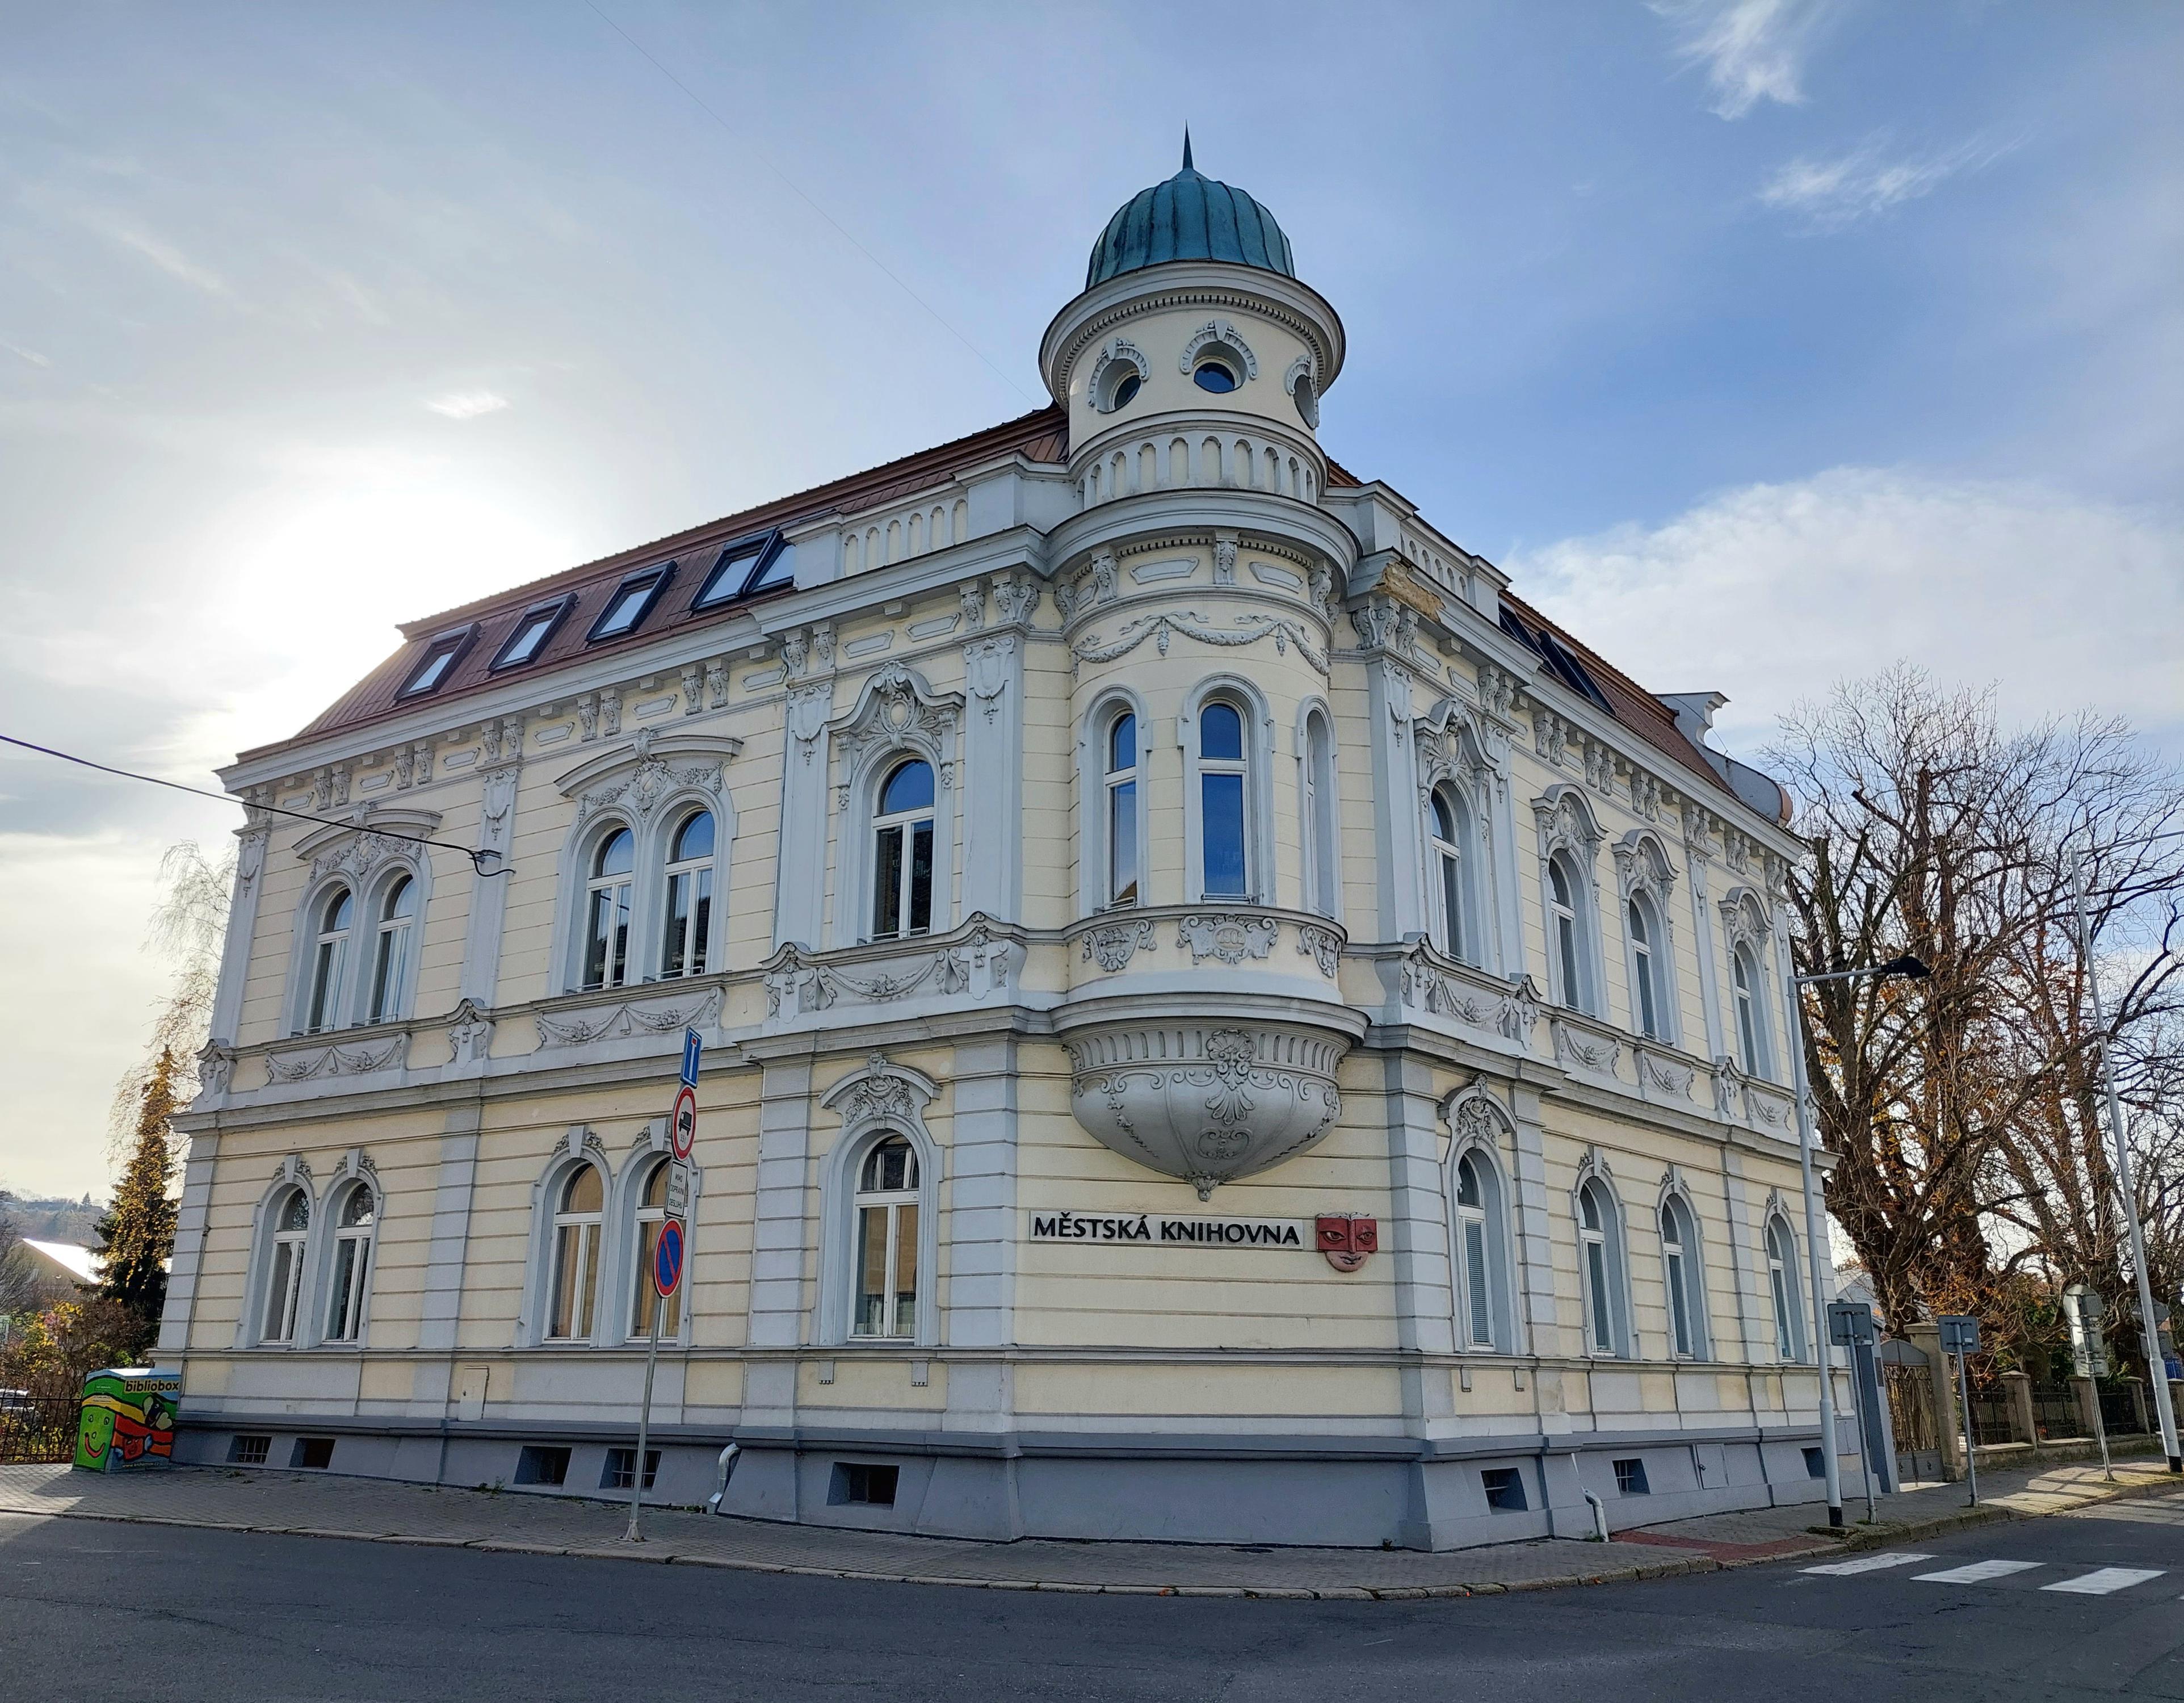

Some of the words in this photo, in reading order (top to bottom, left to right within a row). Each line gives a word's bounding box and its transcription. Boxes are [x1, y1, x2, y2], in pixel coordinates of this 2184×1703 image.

[1219, 930, 1245, 945] 1902
[1034, 1211, 1151, 1240] MĚSTSKÁ
[1161, 1220, 1300, 1245] KNIHOVNA
[125, 1379, 179, 1392] bibliobox
